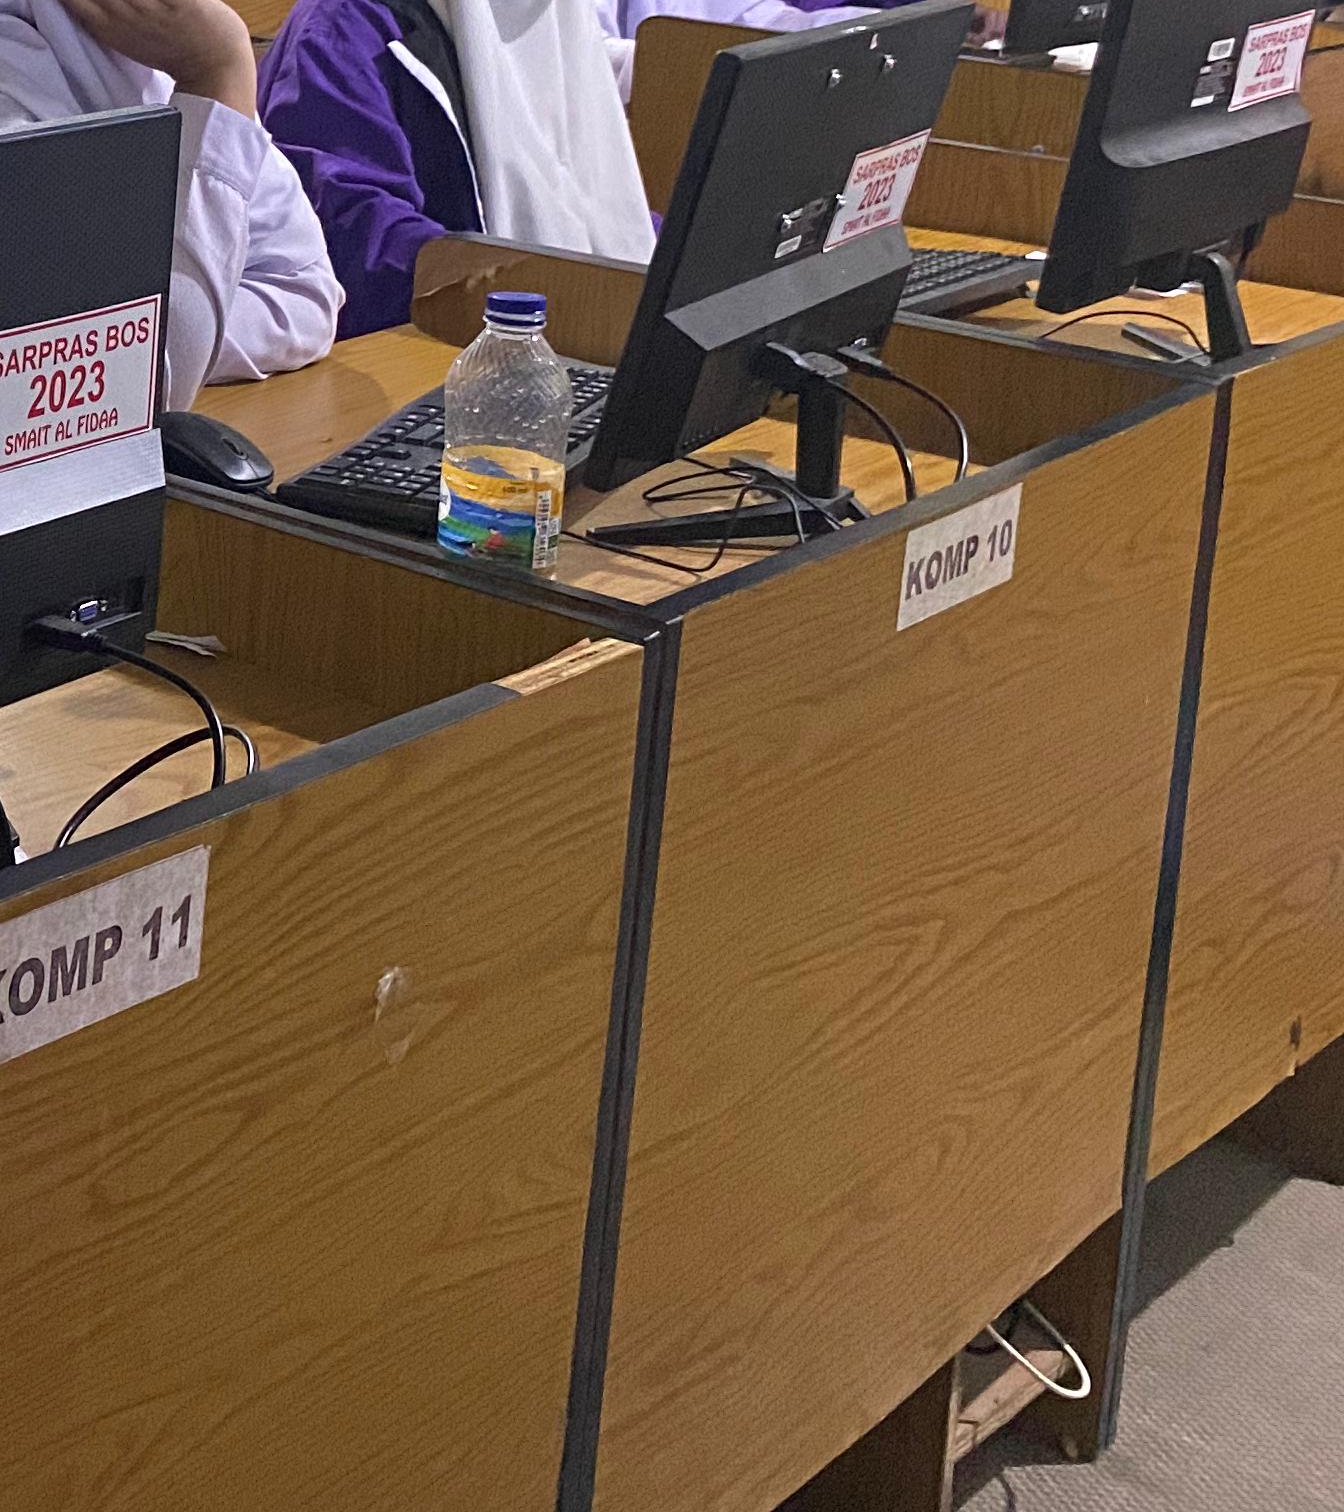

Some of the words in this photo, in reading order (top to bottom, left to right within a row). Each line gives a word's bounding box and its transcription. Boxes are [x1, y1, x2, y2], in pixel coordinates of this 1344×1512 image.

[857, 173, 896, 212] 2023
[105, 317, 150, 352] BOS
[27, 360, 106, 420] 2023
[4, 424, 52, 456] SMAIT
[55, 419, 72, 442] AL
[77, 407, 119, 436] FIDAA
[905, 534, 979, 601] KOMP
[987, 519, 1013, 562] 10
[142, 894, 192, 961] 11
